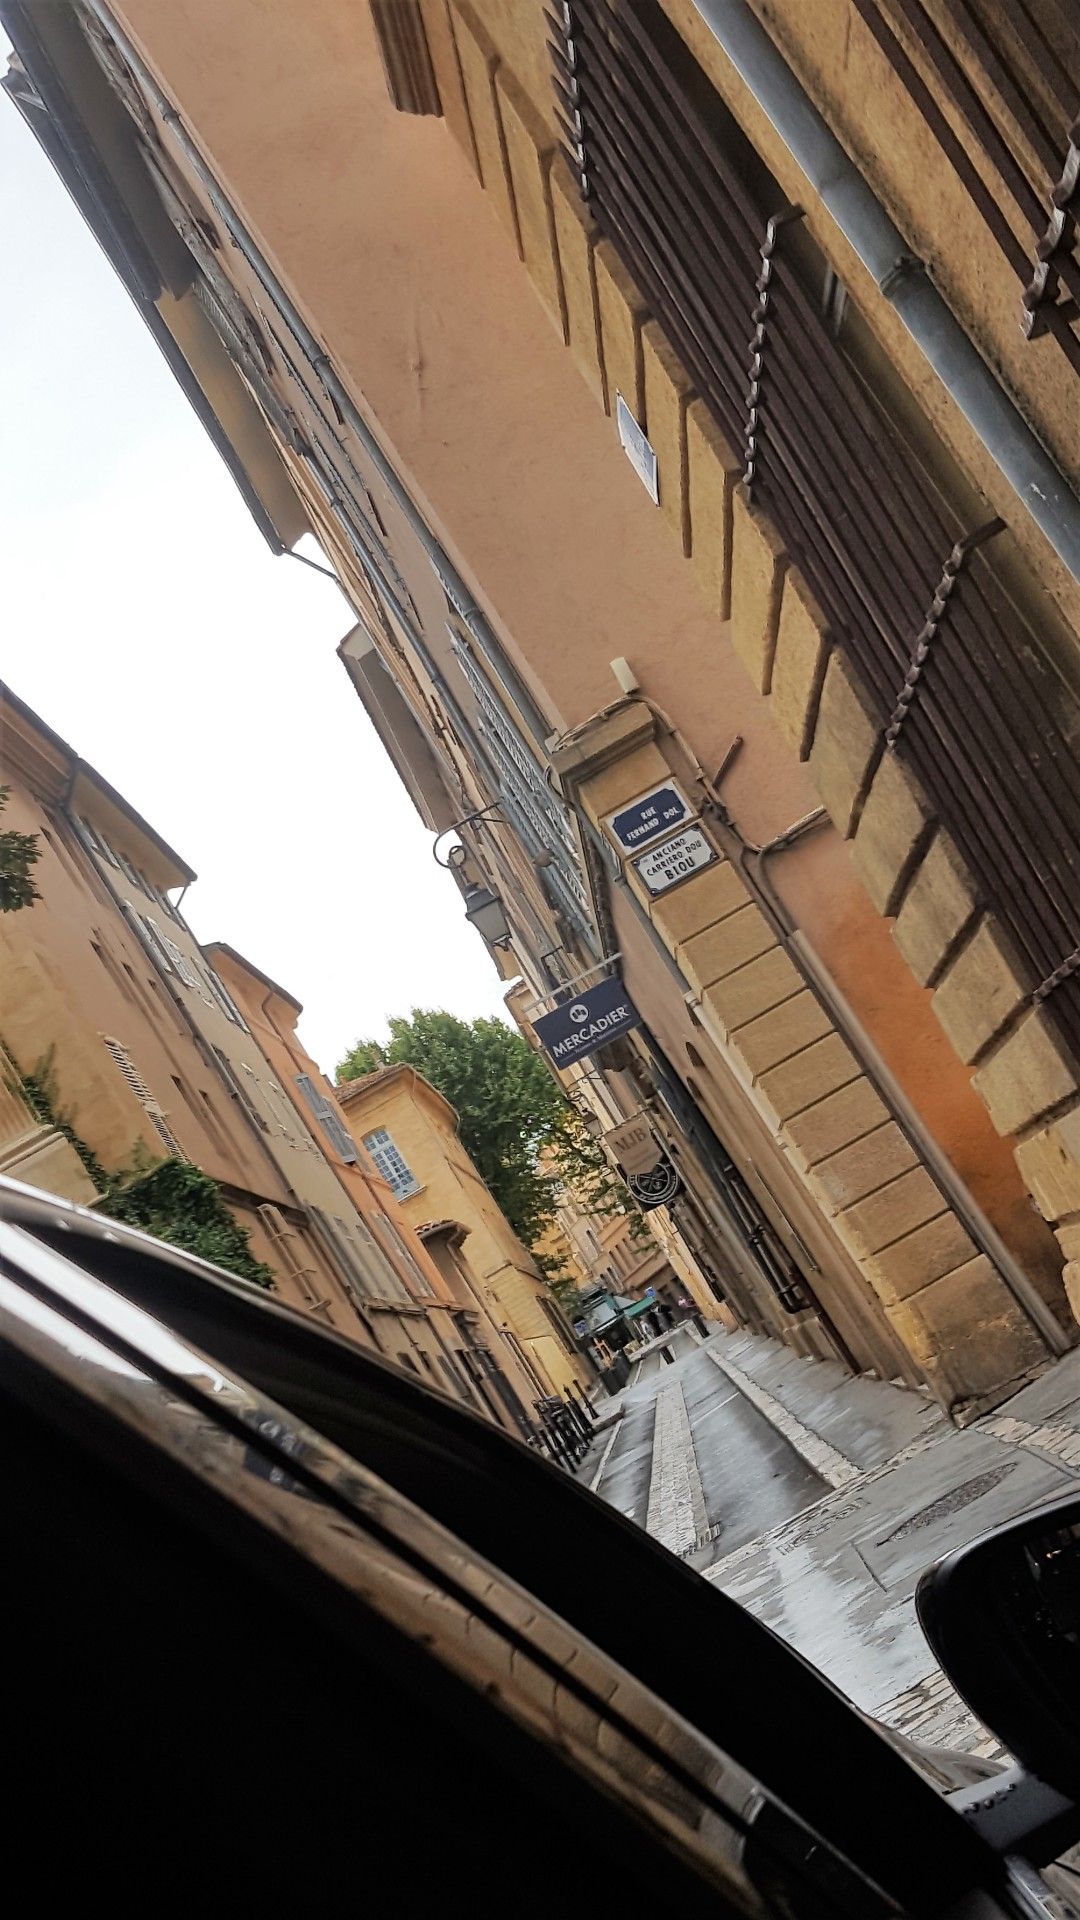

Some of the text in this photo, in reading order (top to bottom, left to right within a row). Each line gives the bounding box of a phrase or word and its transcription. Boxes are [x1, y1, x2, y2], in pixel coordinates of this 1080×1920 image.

[626, 807, 681, 841] FERNAND DOL
[640, 806, 657, 820] RUE
[646, 840, 702, 876] CARRIERO DOU
[652, 838, 687, 862] ANCIANO
[664, 856, 696, 880] BIOU
[552, 1006, 630, 1058] MERCADIER
